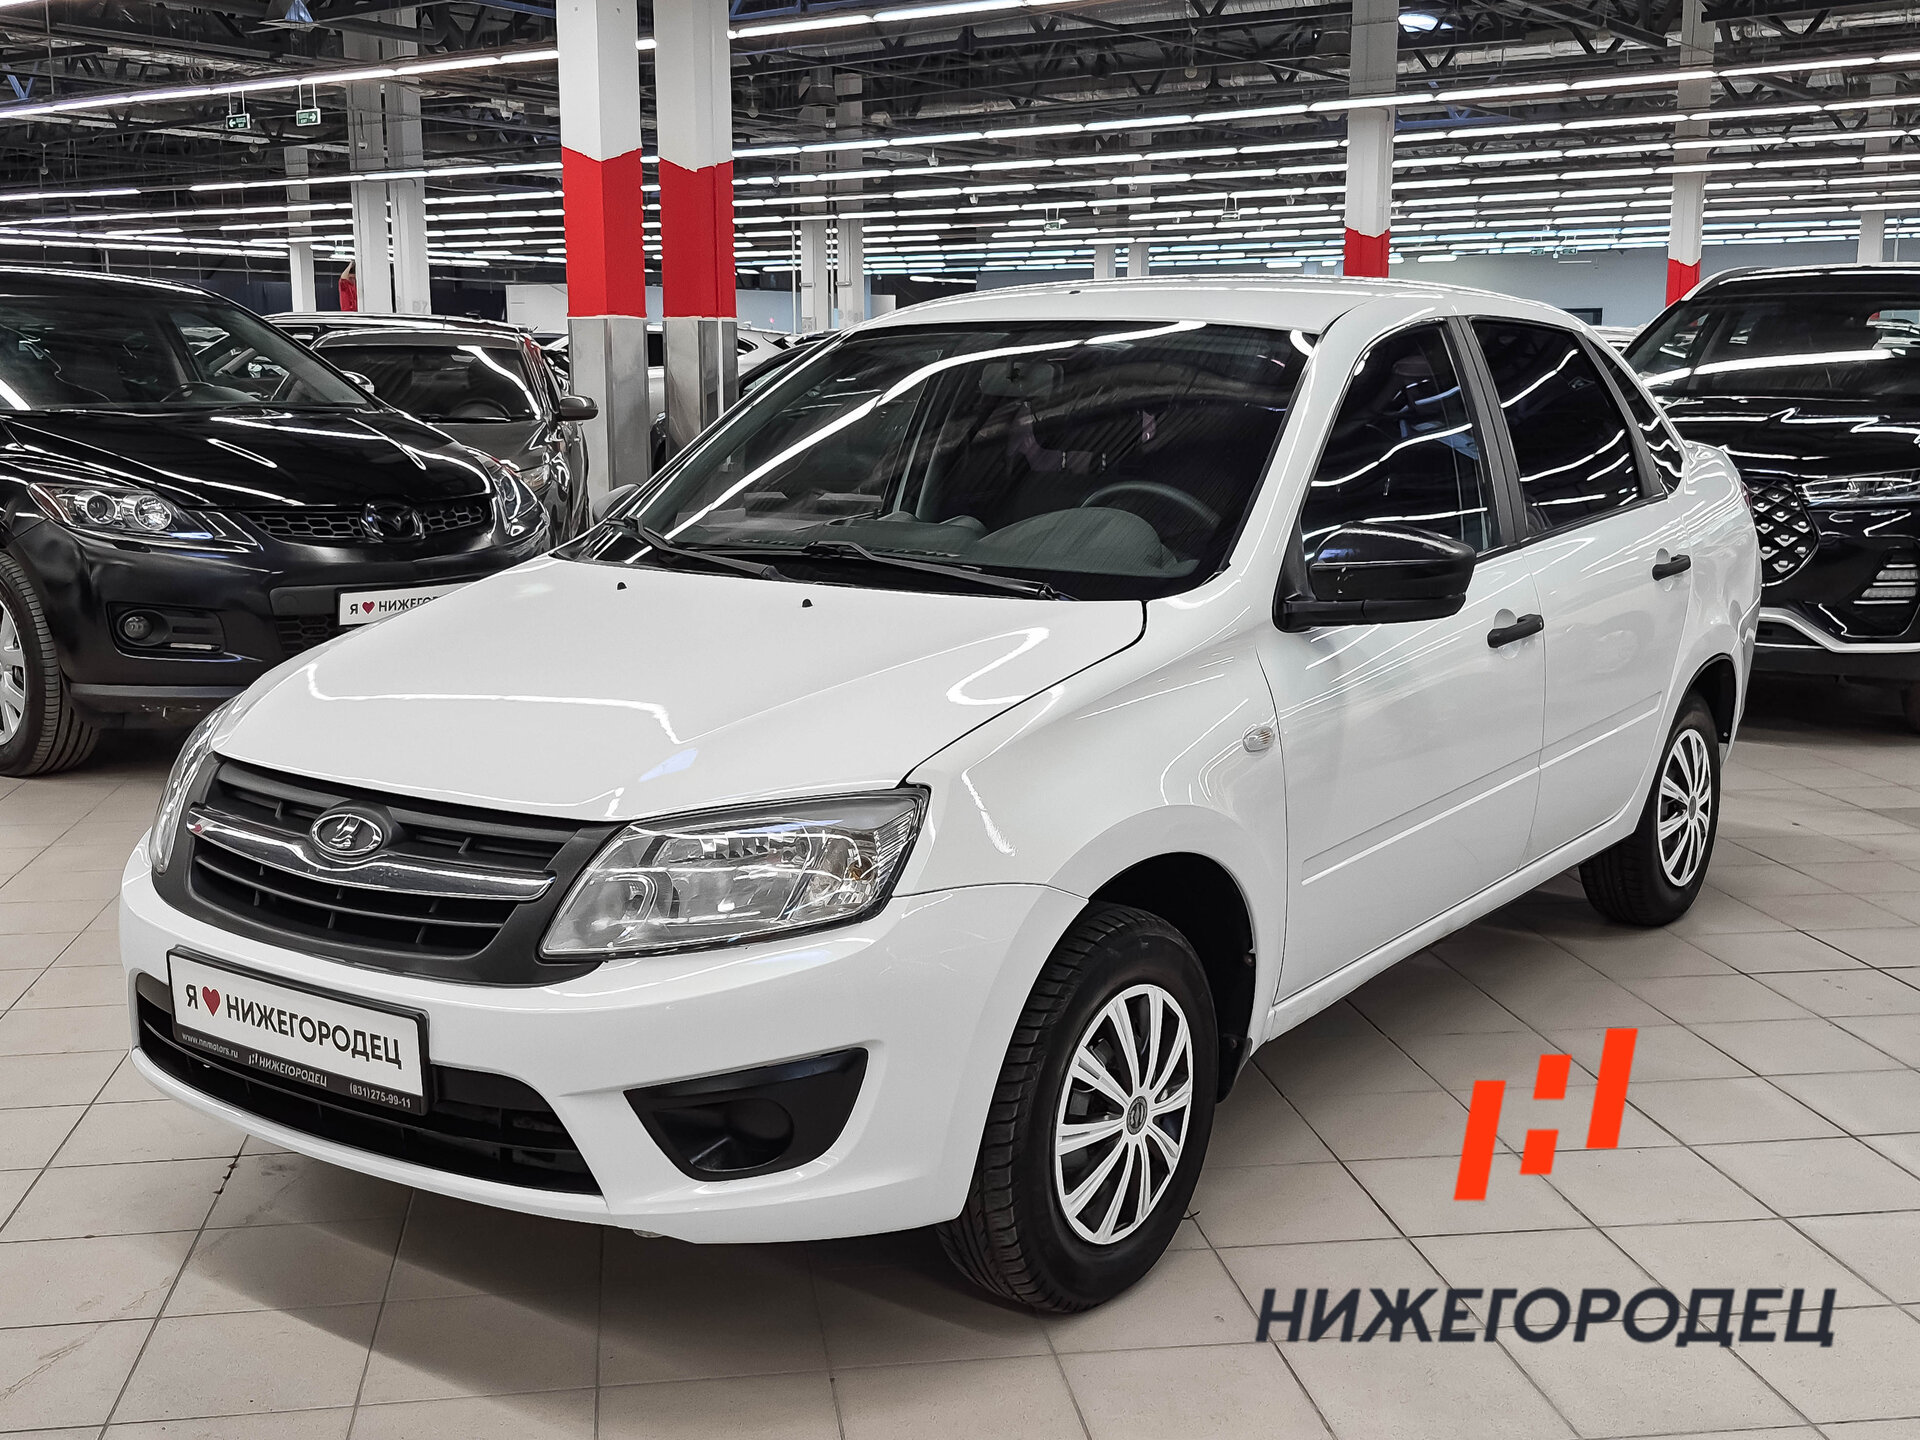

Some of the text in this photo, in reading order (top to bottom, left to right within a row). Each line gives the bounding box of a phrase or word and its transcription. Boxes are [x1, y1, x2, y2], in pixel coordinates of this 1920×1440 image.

[350, 603, 359, 615] Я
[185, 984, 403, 1070] Я НИЖЕГОРОДЕЦ
[259, 1056, 328, 1088] НИЖЕГОРОДЕЦ
[349, 1082, 412, 1108] (831)275-99-11
